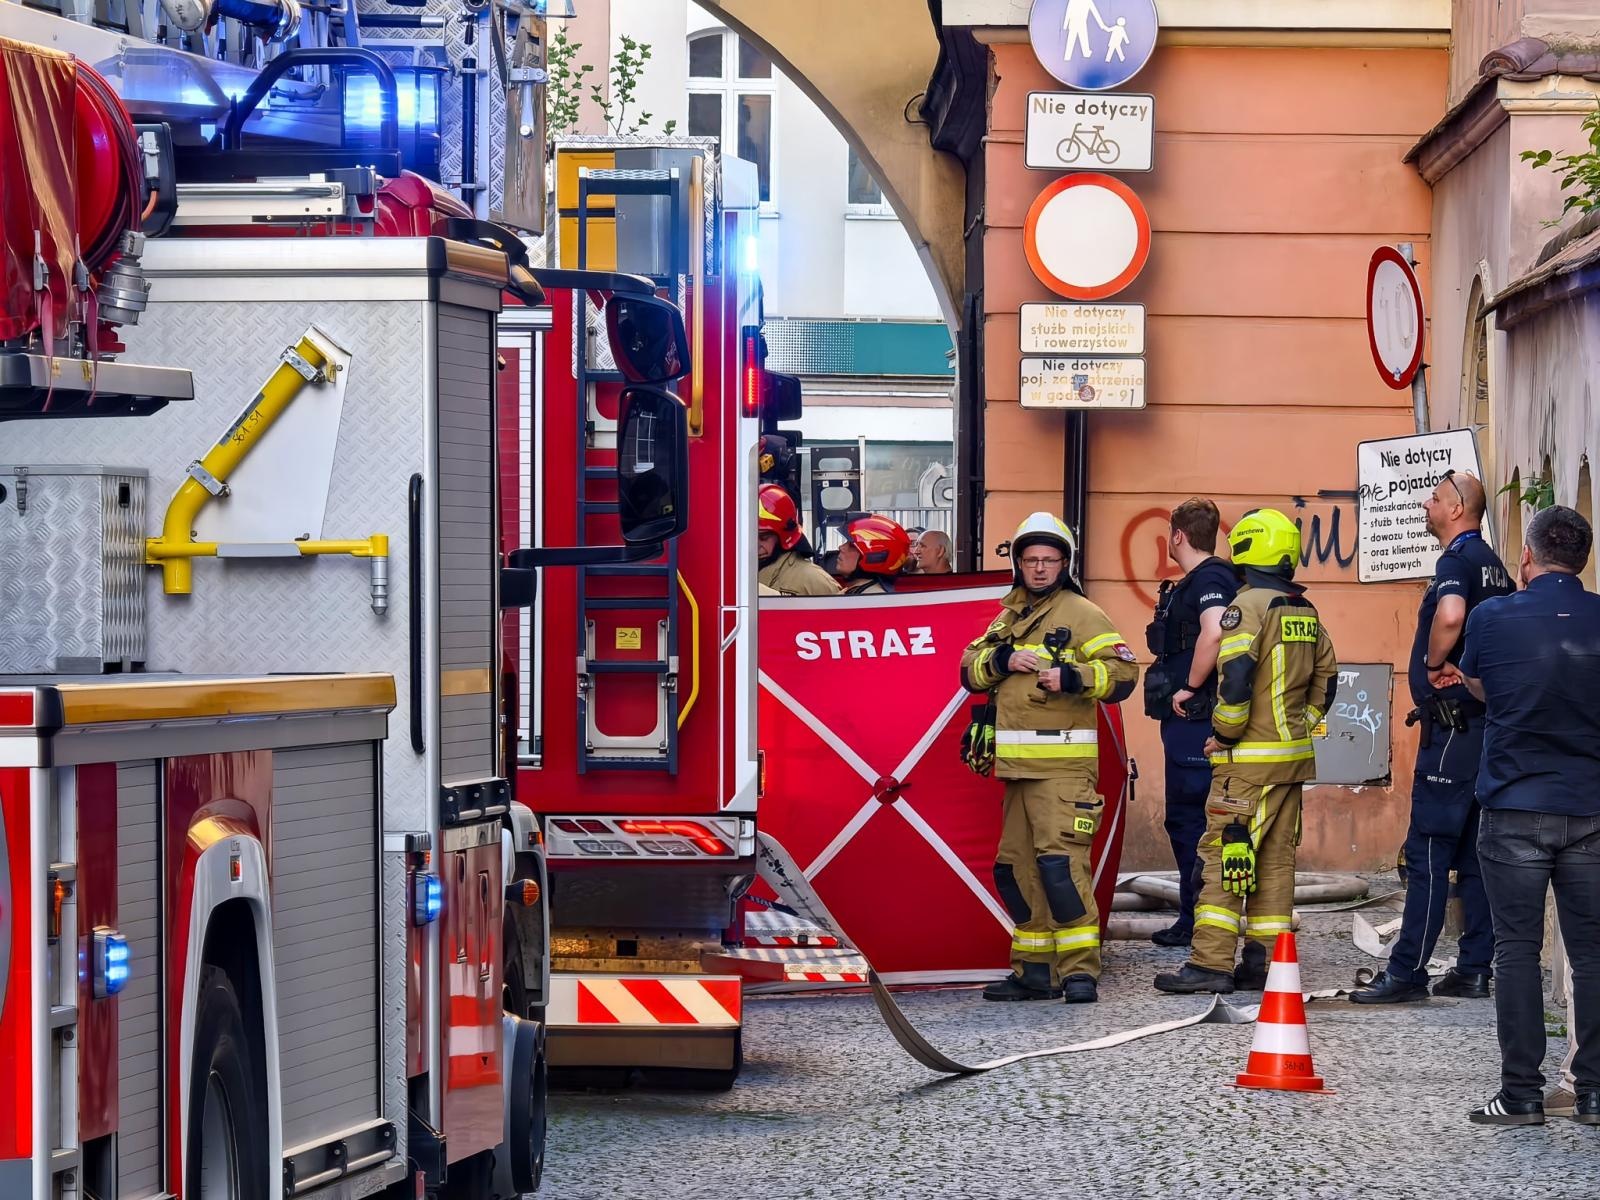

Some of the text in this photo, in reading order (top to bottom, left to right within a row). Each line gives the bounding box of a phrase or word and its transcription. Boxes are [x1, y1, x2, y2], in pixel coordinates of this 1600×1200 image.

[1033, 98, 1148, 122] Nie dotyczy
[1045, 306, 1127, 320] Nie dotyczy
[1072, 323, 1135, 337] miejskich
[1042, 360, 1123, 374] Nie dotyczy
[1380, 447, 1452, 468] Nie dotyczy
[1370, 516, 1393, 528] służb
[1370, 532, 1403, 543] dowozu
[1370, 547, 1389, 557] oraz
[1392, 542, 1428, 556] klientów
[1370, 558, 1422, 573] usługowych
